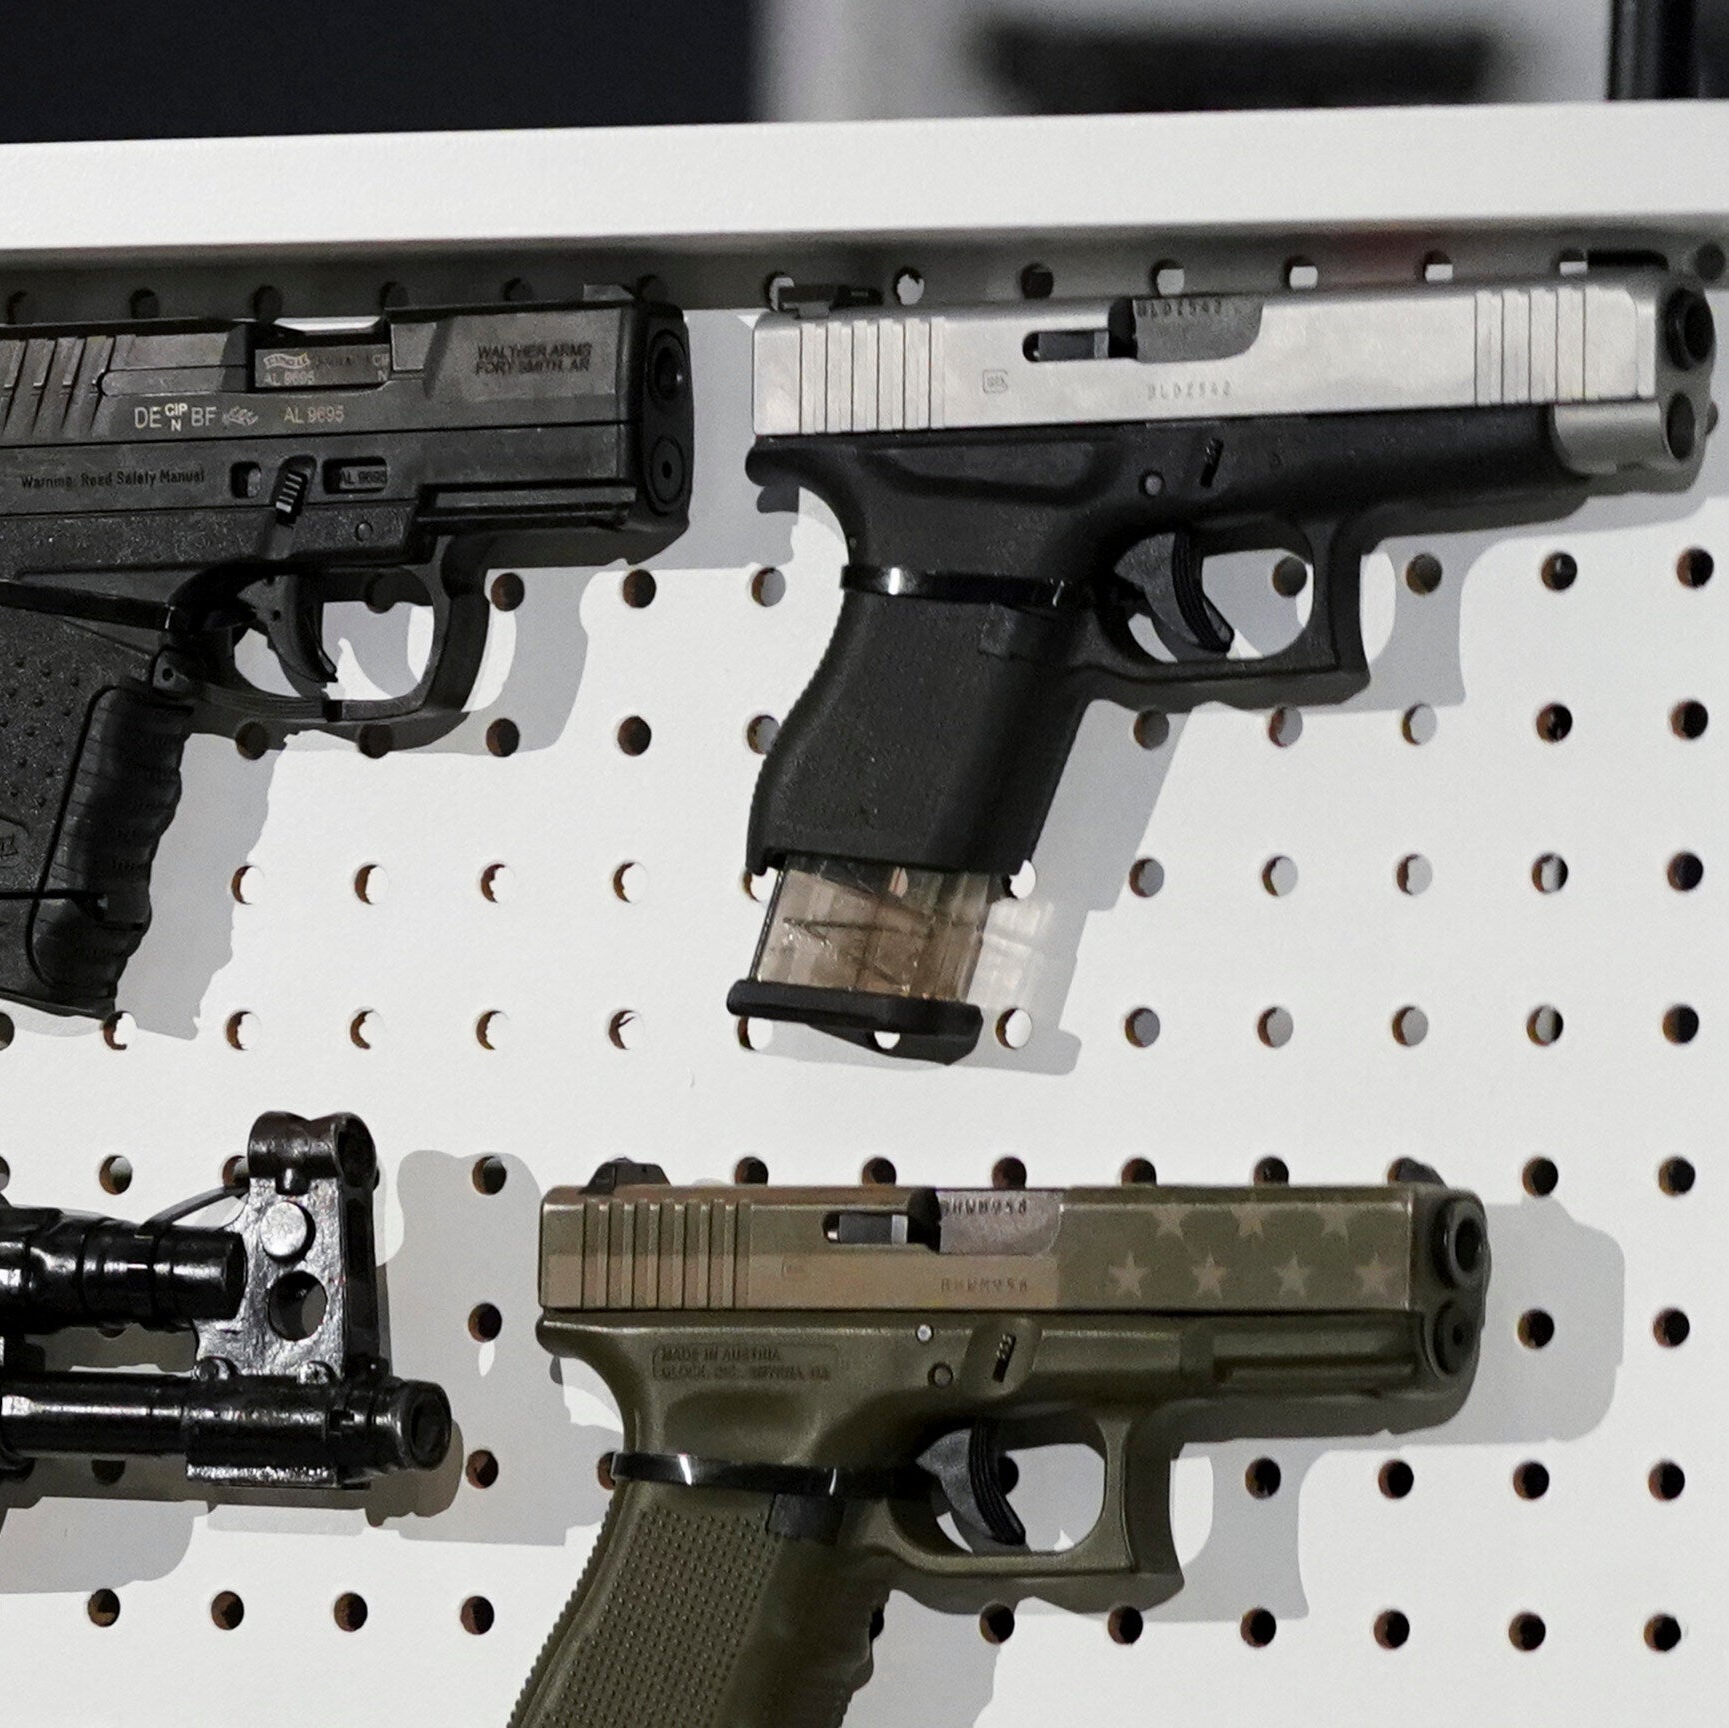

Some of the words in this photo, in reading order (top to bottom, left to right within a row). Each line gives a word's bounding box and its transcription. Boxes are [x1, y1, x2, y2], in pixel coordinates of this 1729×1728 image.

[133, 406, 163, 429] DE
[190, 406, 218, 427] BF
[282, 406, 305, 425] AL
[158, 467, 206, 485] Manual
